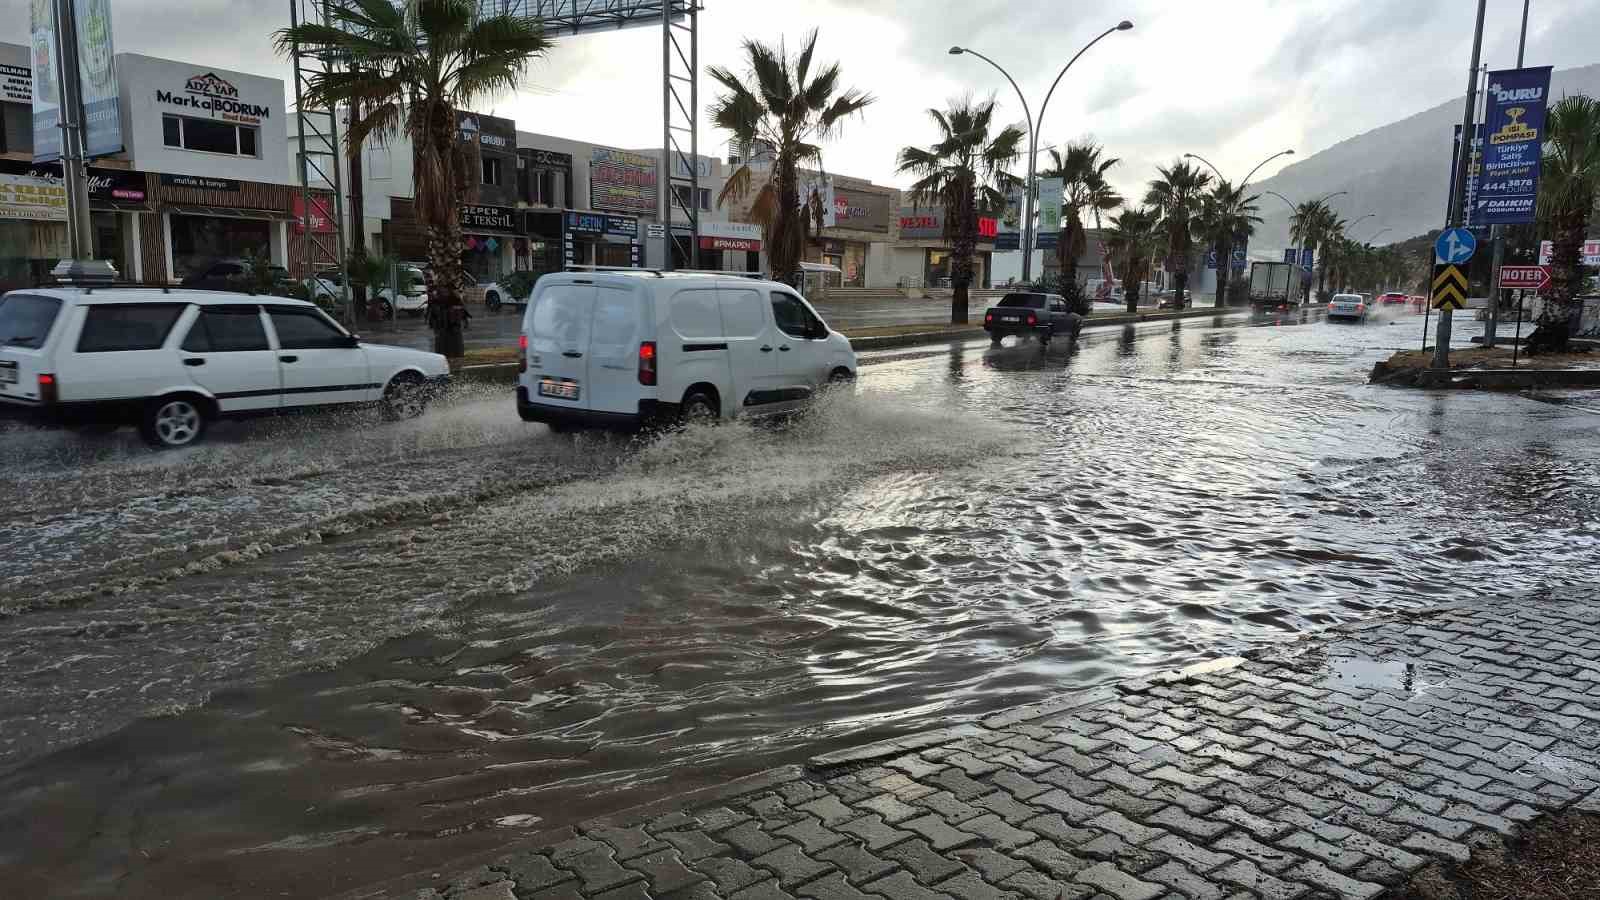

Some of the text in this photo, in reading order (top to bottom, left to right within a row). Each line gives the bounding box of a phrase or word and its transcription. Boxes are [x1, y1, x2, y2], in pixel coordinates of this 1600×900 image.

[1497, 87, 1542, 101] DURU
[156, 89, 270, 118] Marka BODRUM
[1482, 178, 1533, 191] 444 3878
[1488, 199, 1533, 208] DAIKIN
[1501, 269, 1542, 281] NOTER
